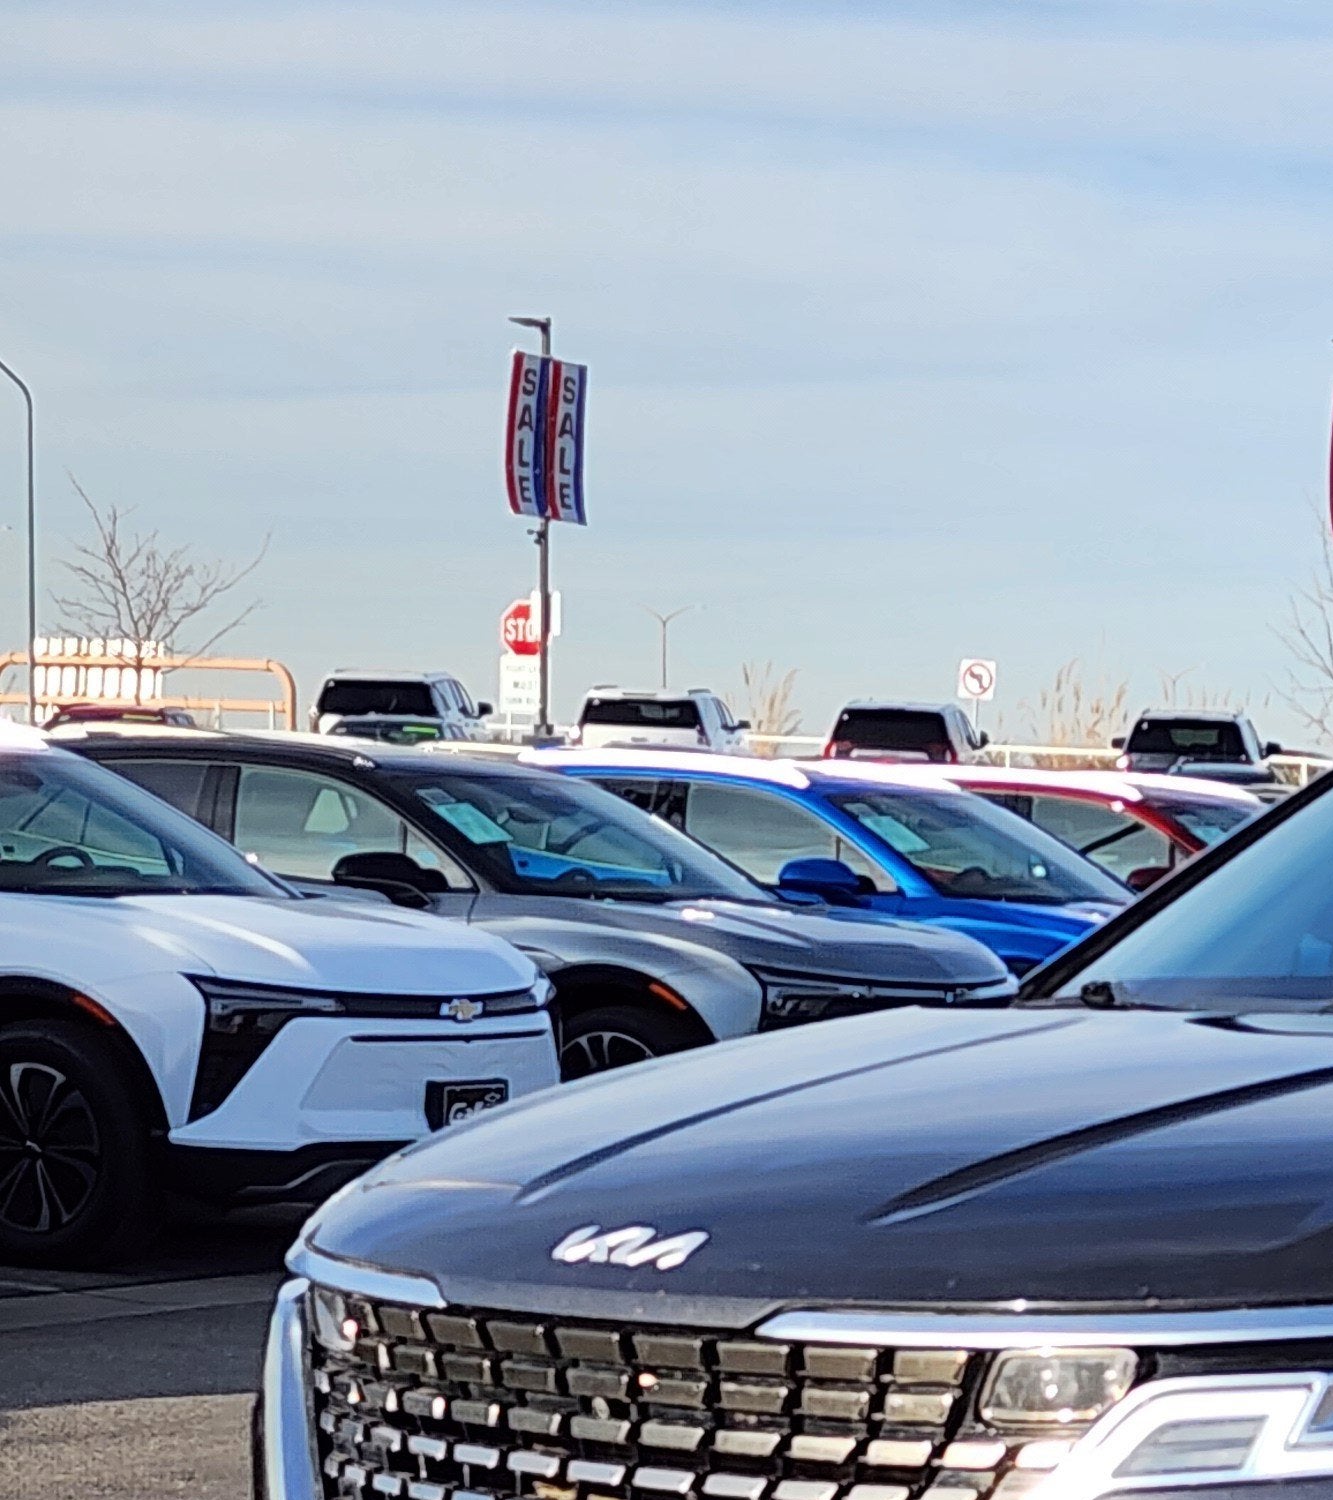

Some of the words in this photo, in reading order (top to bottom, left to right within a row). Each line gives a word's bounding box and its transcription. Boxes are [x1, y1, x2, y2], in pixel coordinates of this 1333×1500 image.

[517, 368, 538, 503] SALE
[557, 376, 576, 510] SALE
[505, 617, 541, 642] STO
